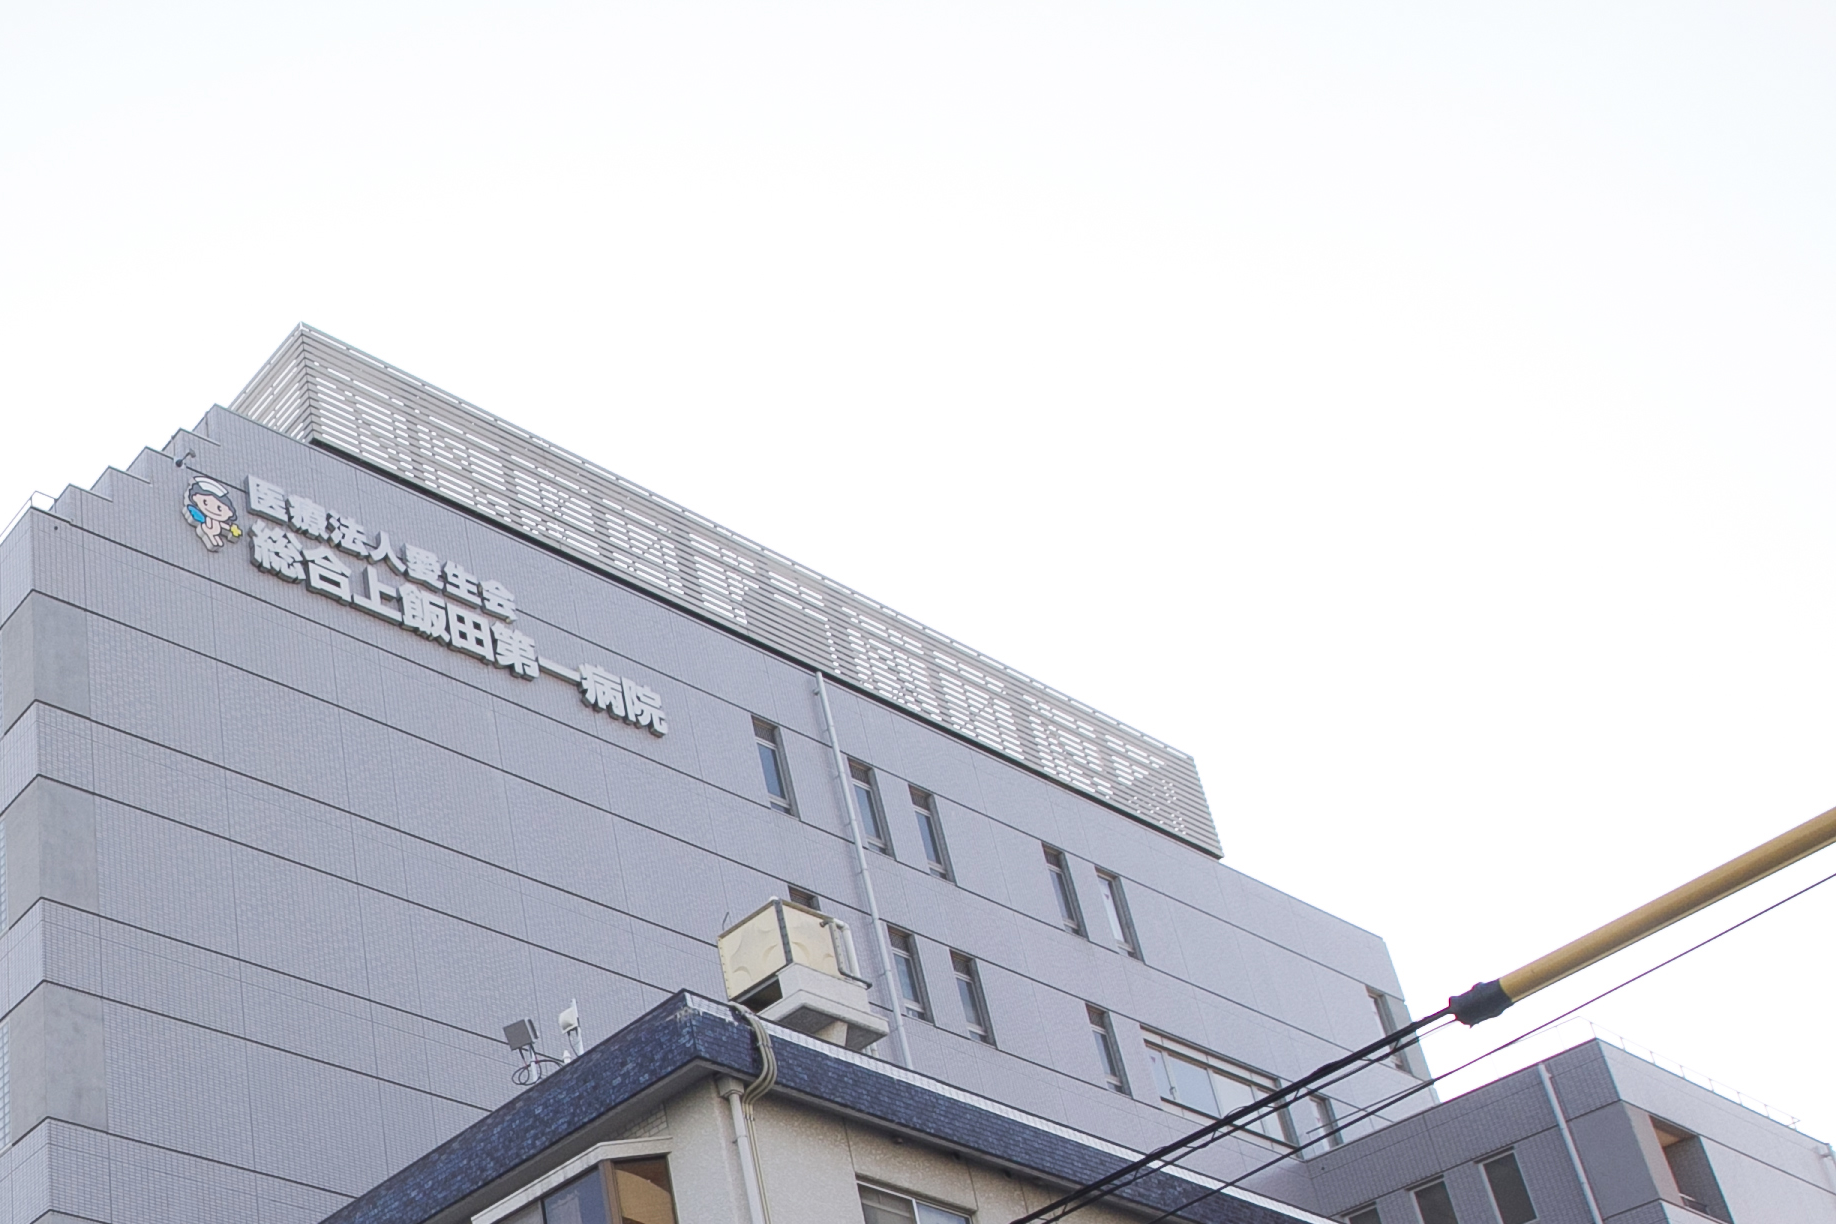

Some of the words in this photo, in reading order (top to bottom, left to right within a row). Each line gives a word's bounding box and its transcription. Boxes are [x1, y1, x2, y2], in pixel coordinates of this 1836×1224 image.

[245, 474, 518, 623] 医療法人愛生会
[250, 519, 668, 738] 総合上飯田第一病院
